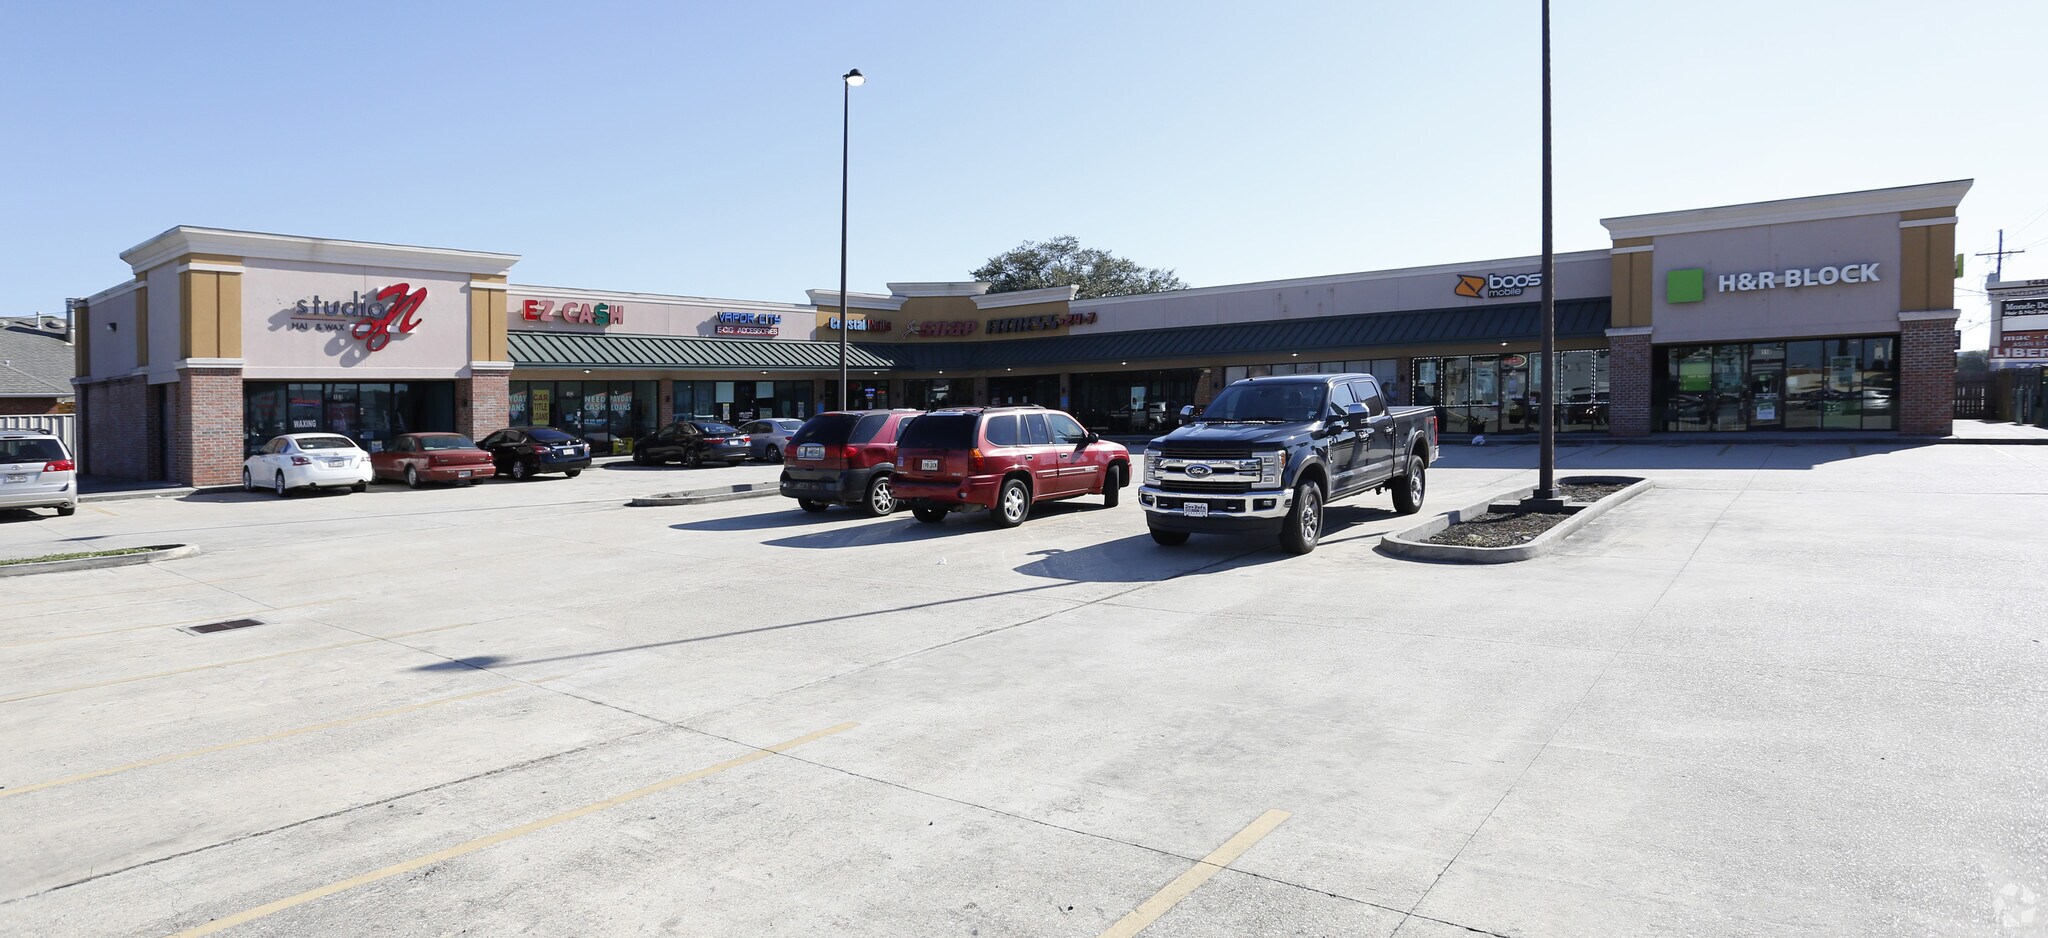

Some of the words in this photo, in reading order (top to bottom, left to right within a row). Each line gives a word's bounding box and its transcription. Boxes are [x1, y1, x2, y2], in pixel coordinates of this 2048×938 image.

[1489, 273, 1542, 289] boos
[1718, 271, 1776, 292] H&R
[1784, 262, 1881, 288] BLOCK
[1488, 288, 1521, 297] mobile
[296, 290, 385, 318] studio
[523, 299, 555, 321] EZ
[717, 312, 755, 324] VAPOR
[759, 313, 781, 325] CITY
[315, 322, 323, 330] &
[324, 323, 345, 331] WAX
[829, 316, 867, 332] Crstal
[737, 327, 778, 335] ACCESSORIES
[534, 393, 548, 401] CAR
[584, 395, 605, 403] NEED
[610, 395, 632, 403] PAYDAY
[534, 403, 547, 411] TITLE
[293, 420, 316, 428] WAXING
